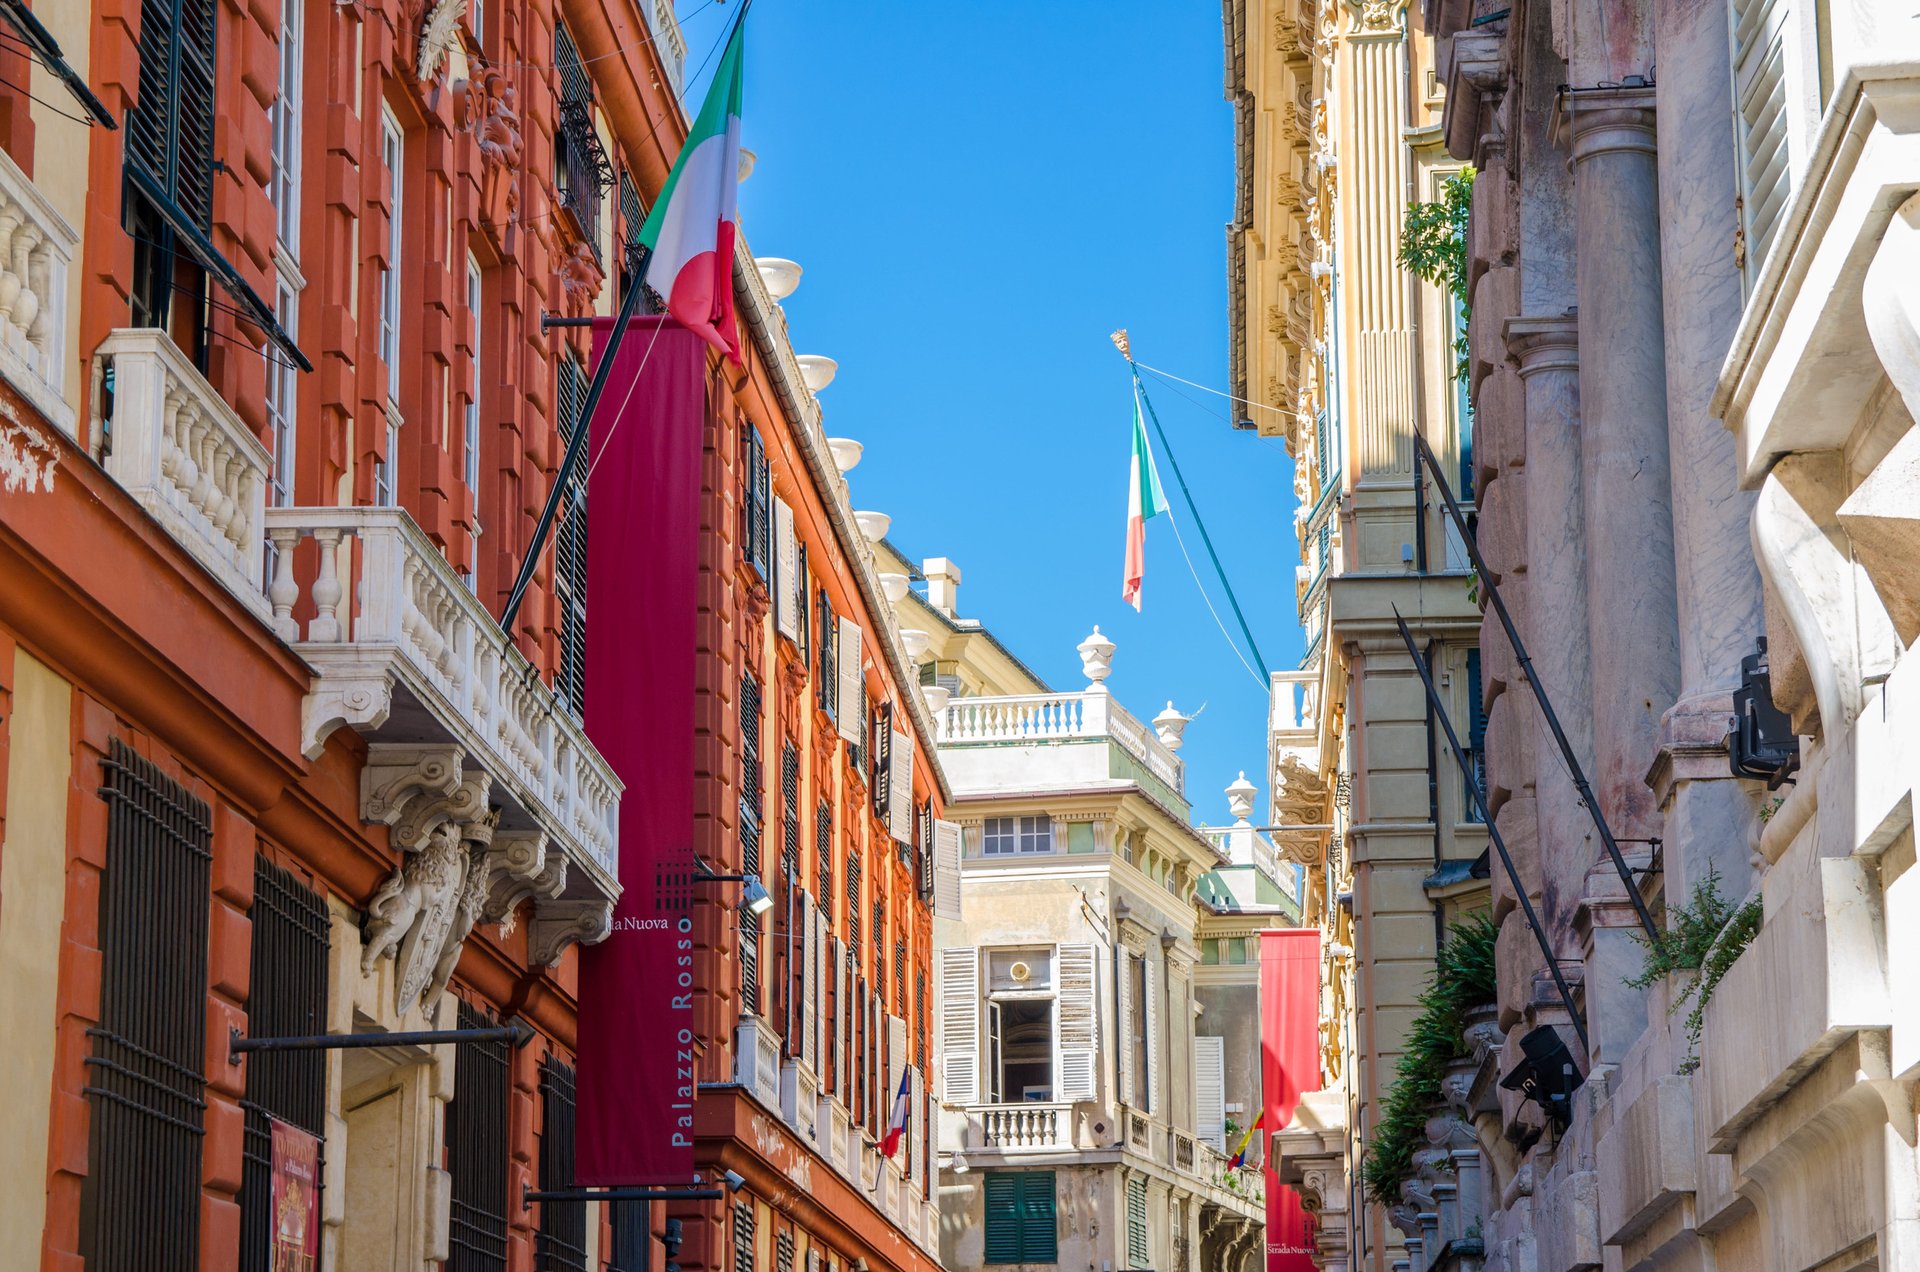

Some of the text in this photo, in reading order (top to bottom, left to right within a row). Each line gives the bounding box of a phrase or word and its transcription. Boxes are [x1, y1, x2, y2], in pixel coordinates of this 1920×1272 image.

[624, 916, 668, 930] Nuova
[671, 918, 692, 1147] Palazzo Rosso
[1267, 1246, 1314, 1254] Strada Nuova
